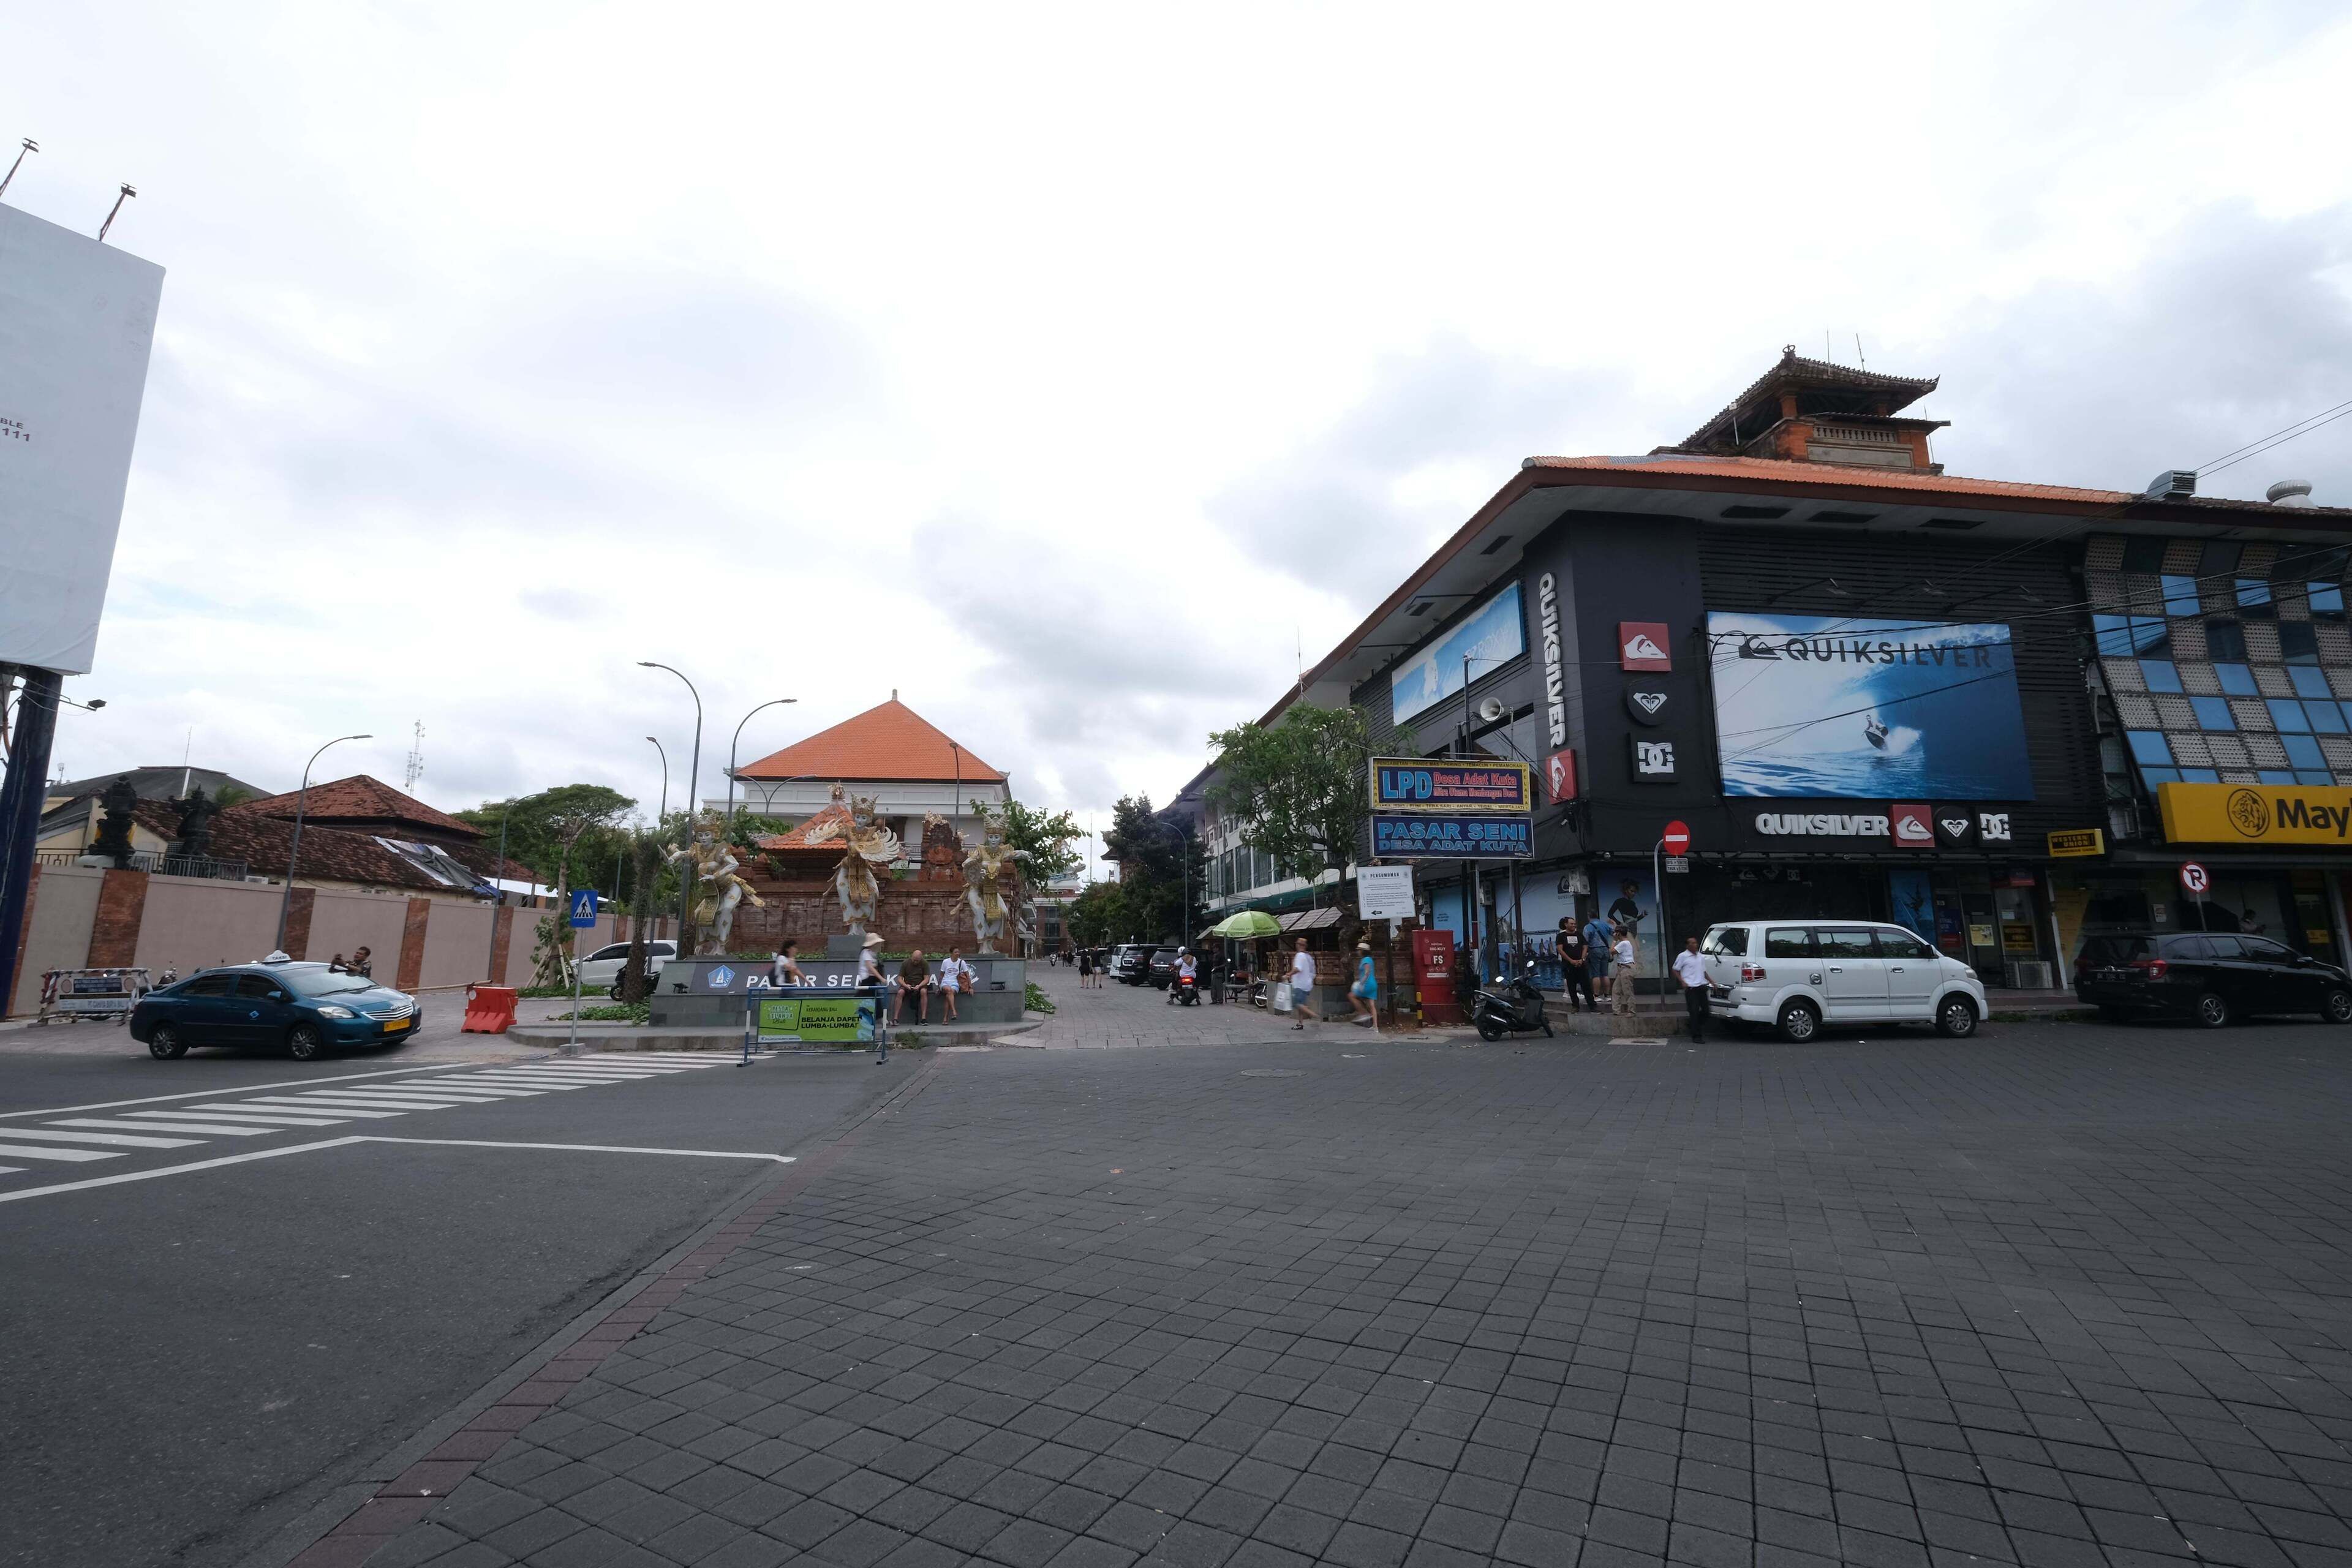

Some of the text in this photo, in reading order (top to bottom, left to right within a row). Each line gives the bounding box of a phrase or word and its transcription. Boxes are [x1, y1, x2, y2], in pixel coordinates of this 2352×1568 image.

[1539, 572, 1566, 748] QUIKSILVER
[1785, 638, 1992, 668] QUIKSILVER
[1382, 771, 1433, 799] LPD
[1433, 771, 1517, 786] Desa Adat Kuta
[1755, 813, 1890, 835] QUIKSILVER
[2276, 797, 2352, 837] May
[1378, 822, 1526, 840] PASAR SENI
[1378, 840, 1528, 852] DESA ADAT KUTA
[2189, 869, 2202, 886] P
[1433, 955, 1444, 964] FS
[746, 975, 816, 987] PAAR
[827, 974, 861, 987] SE
